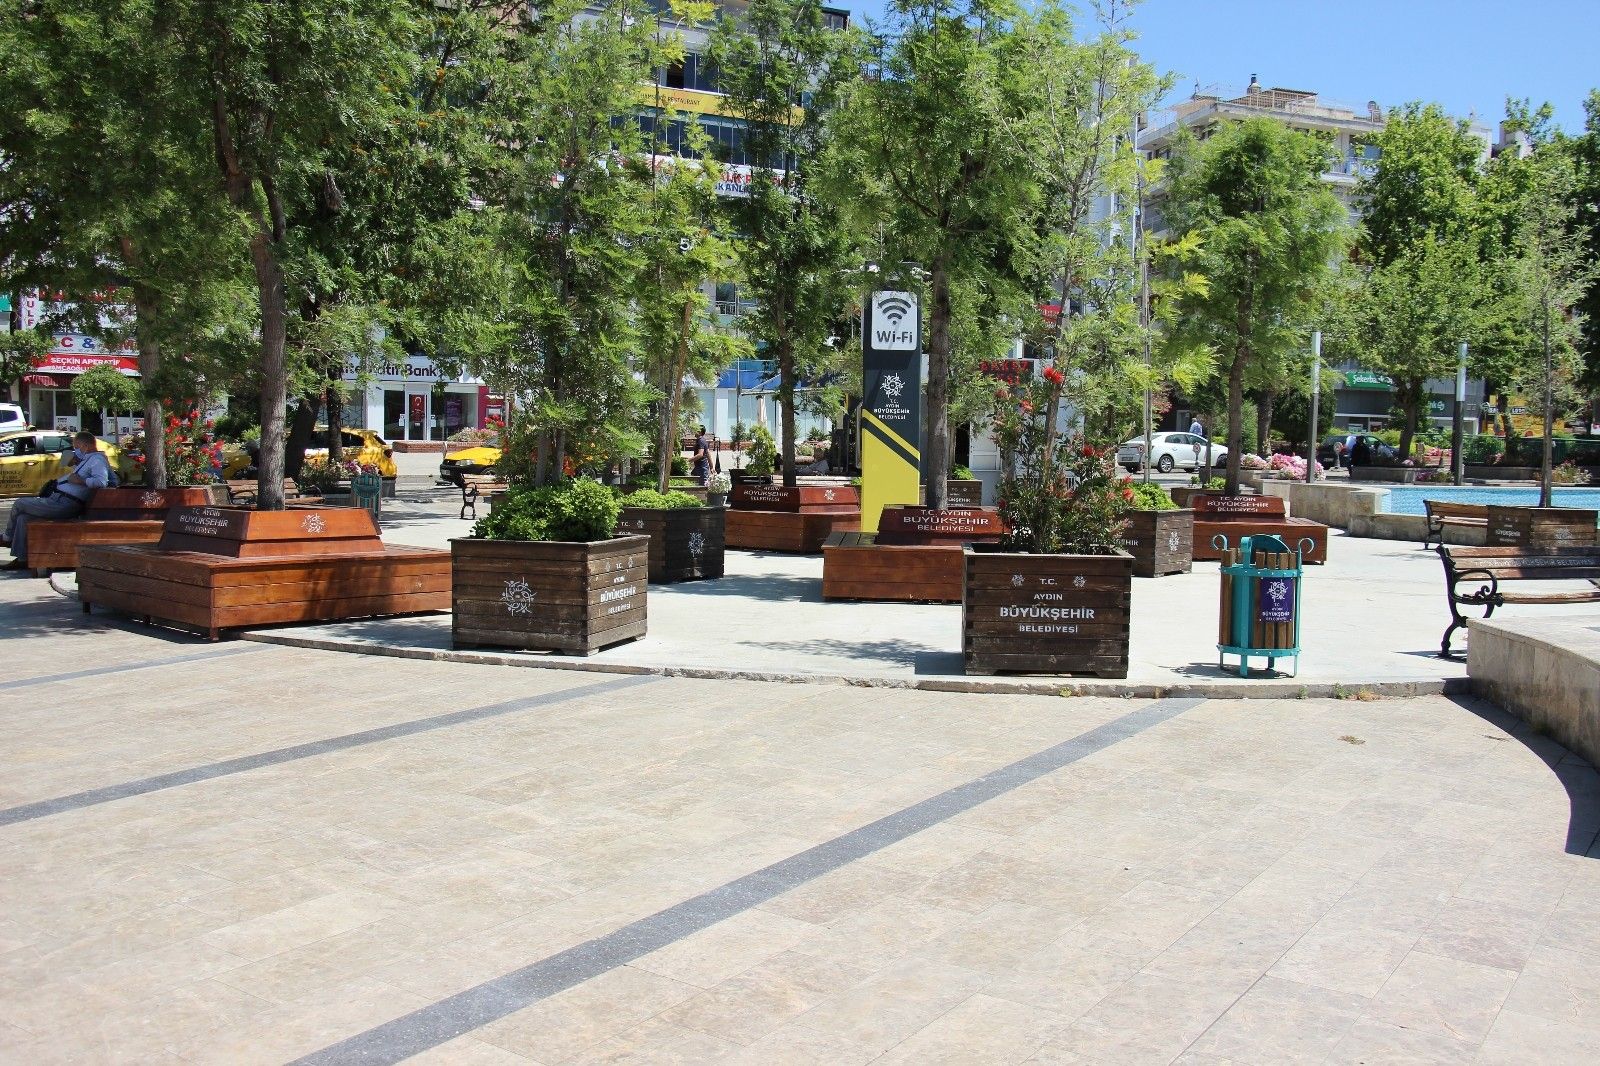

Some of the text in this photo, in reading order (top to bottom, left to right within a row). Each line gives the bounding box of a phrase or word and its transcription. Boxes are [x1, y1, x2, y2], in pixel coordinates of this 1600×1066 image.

[876, 330, 913, 344] Wi-Fi
[50, 357, 81, 366] SEÇKİN
[940, 509, 972, 517] AYDIN
[903, 515, 989, 526] BÜYÜKŞEHİR
[917, 523, 974, 532] BELEDİYESİ
[1039, 578, 1058, 586] T.C.
[600, 584, 637, 603] BÜYÜKŞEHİR
[1033, 592, 1064, 601] AYDIN
[1000, 604, 1095, 621] BÜYÜKŞEHİR
[1018, 624, 1078, 633] BELEDİYESİ
